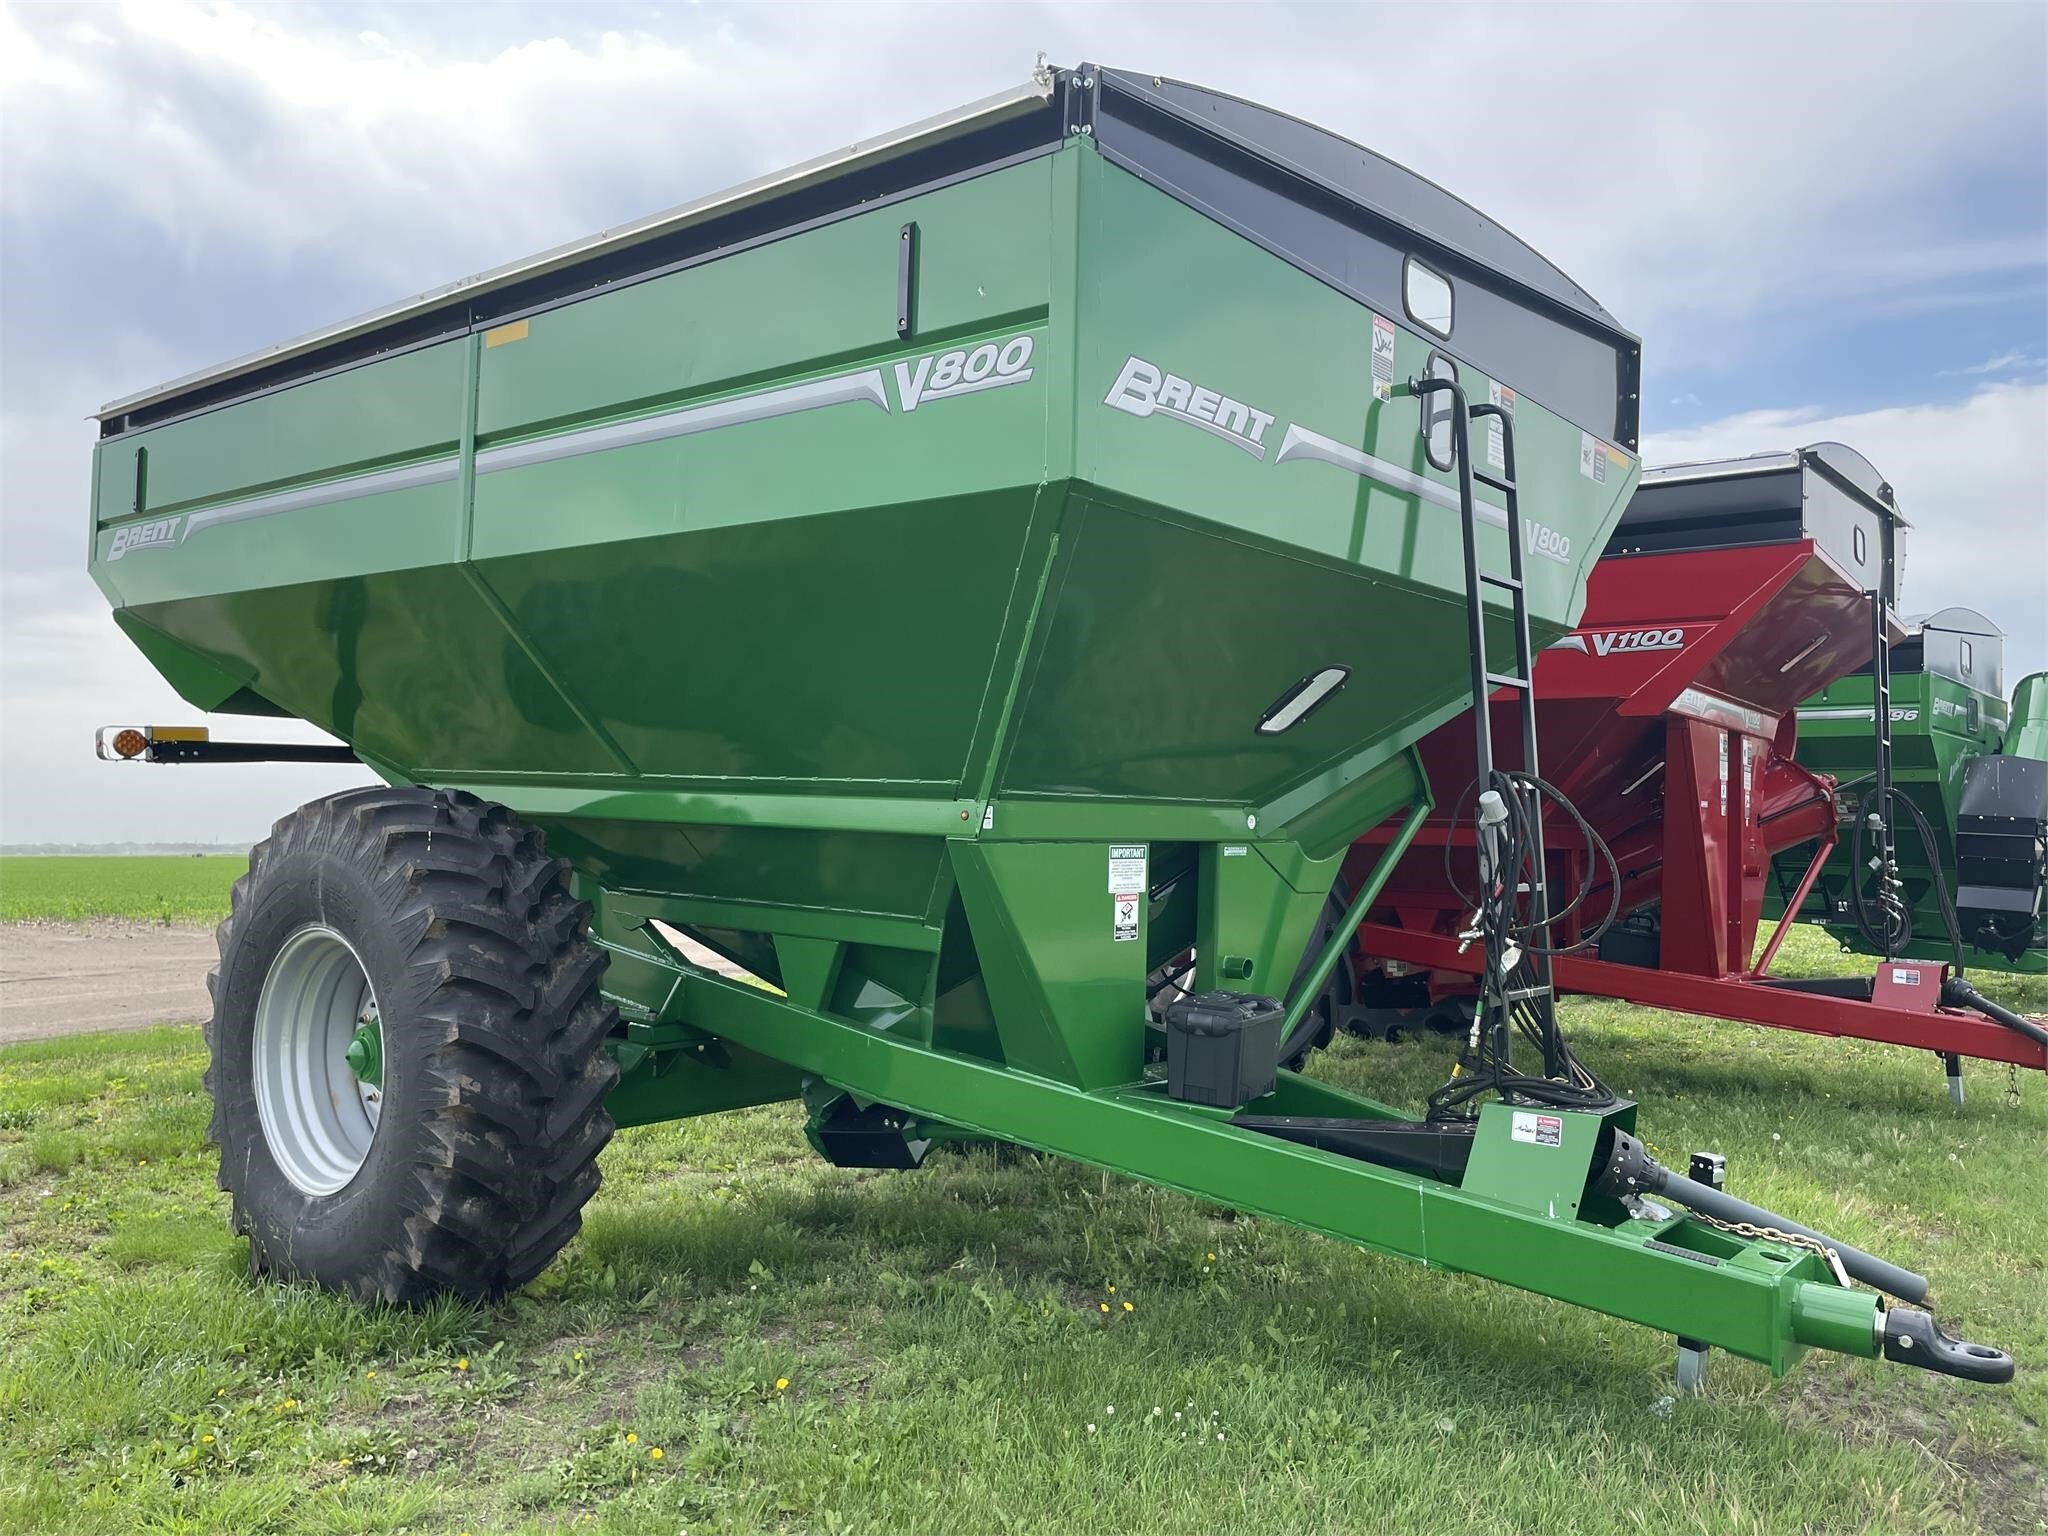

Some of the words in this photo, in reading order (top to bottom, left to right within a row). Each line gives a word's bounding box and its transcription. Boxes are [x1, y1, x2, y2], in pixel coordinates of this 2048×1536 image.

[894, 336, 1034, 412] V800
[1103, 355, 1276, 447] BRENT
[1525, 518, 1570, 558] V800
[1592, 629, 1684, 656] V1100
[1869, 709, 1919, 722] 196
[1111, 848, 1145, 858] IMPORTANT
